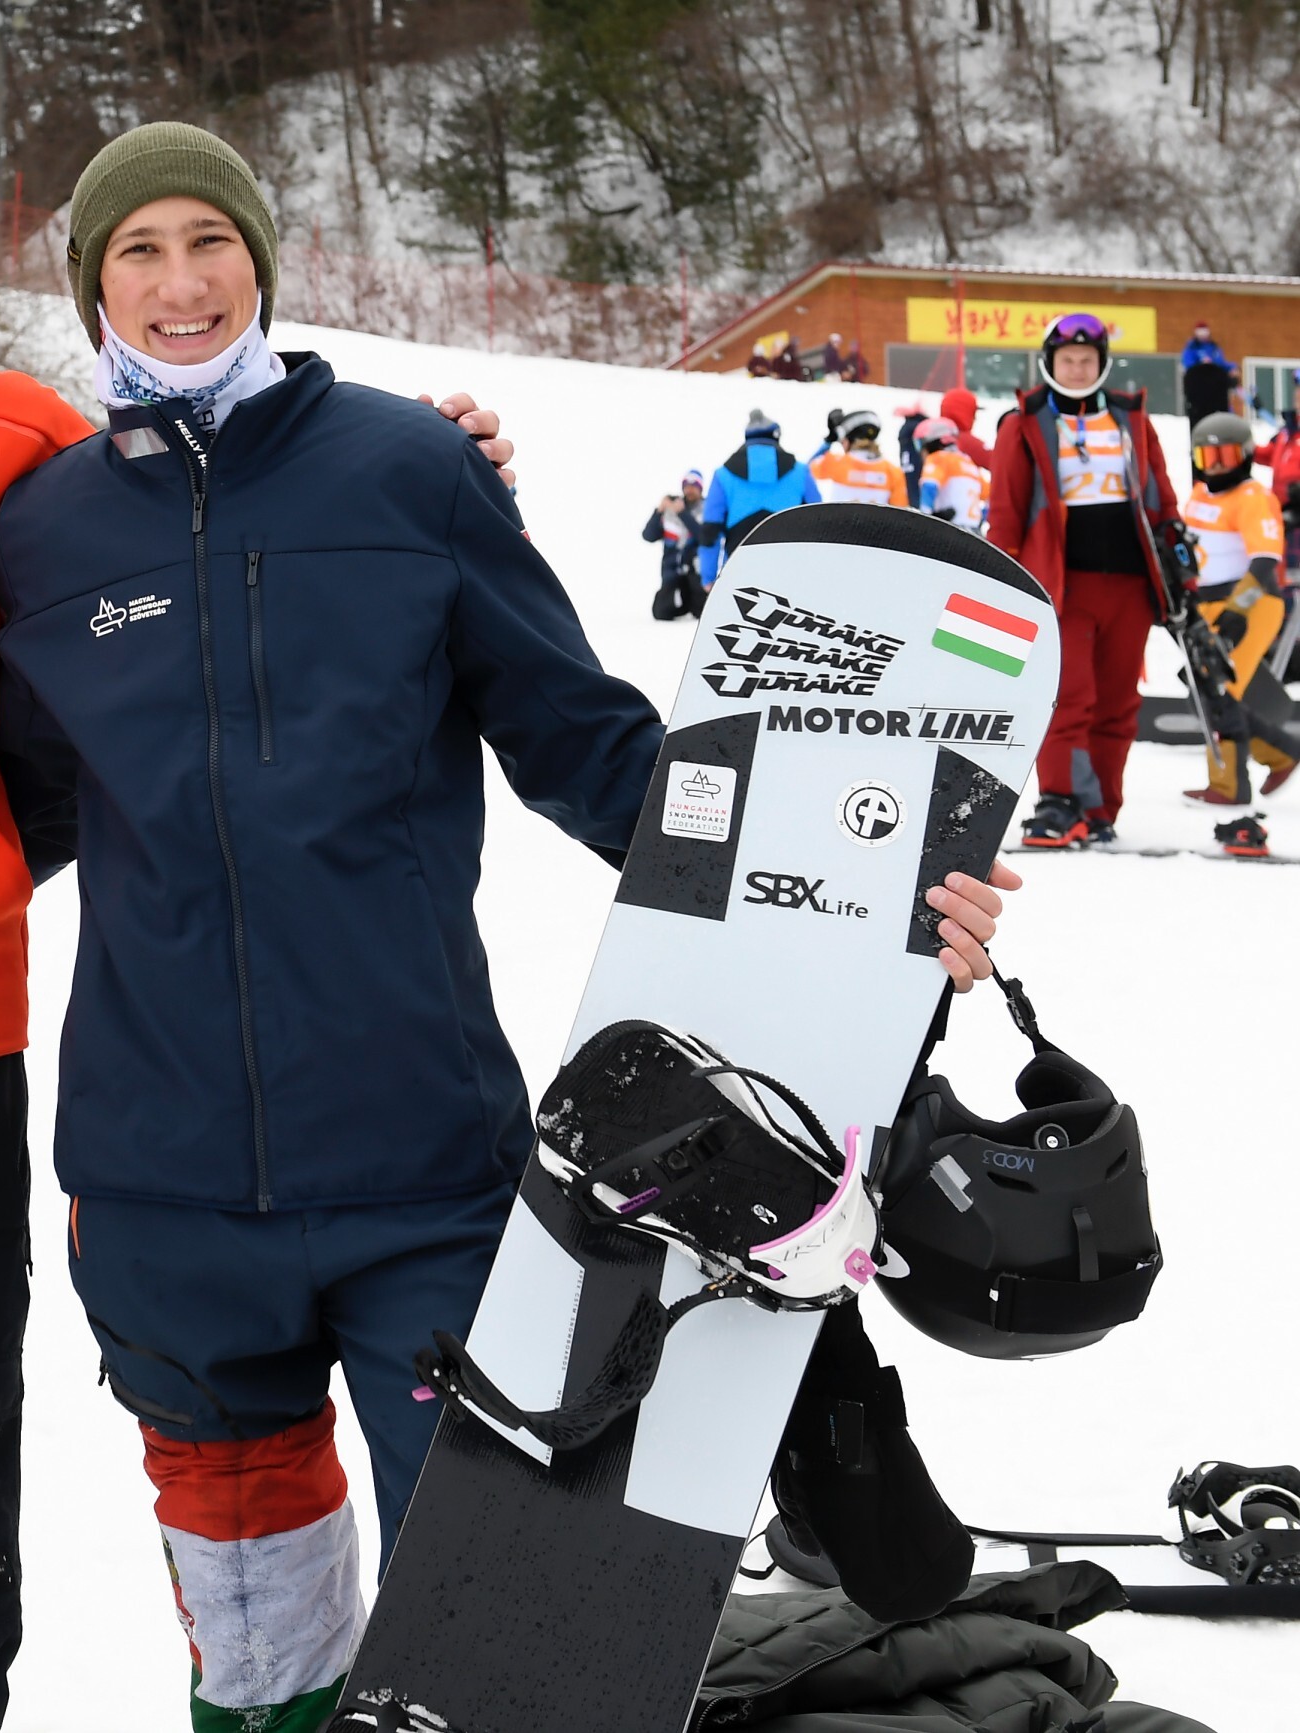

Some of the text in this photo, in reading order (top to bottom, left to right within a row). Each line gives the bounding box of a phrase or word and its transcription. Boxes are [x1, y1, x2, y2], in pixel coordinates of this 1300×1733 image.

[174, 419, 204, 452] HELLY
[128, 594, 156, 607] MAGYAR
[782, 607, 906, 659] DRAKE
[767, 637, 893, 677] DRAKE
[756, 669, 881, 697] DRAKE
[669, 802, 727, 816] HUNGARIAN
[669, 811, 726, 824] SNOWBOARD
[667, 820, 725, 833] FEDERATION
